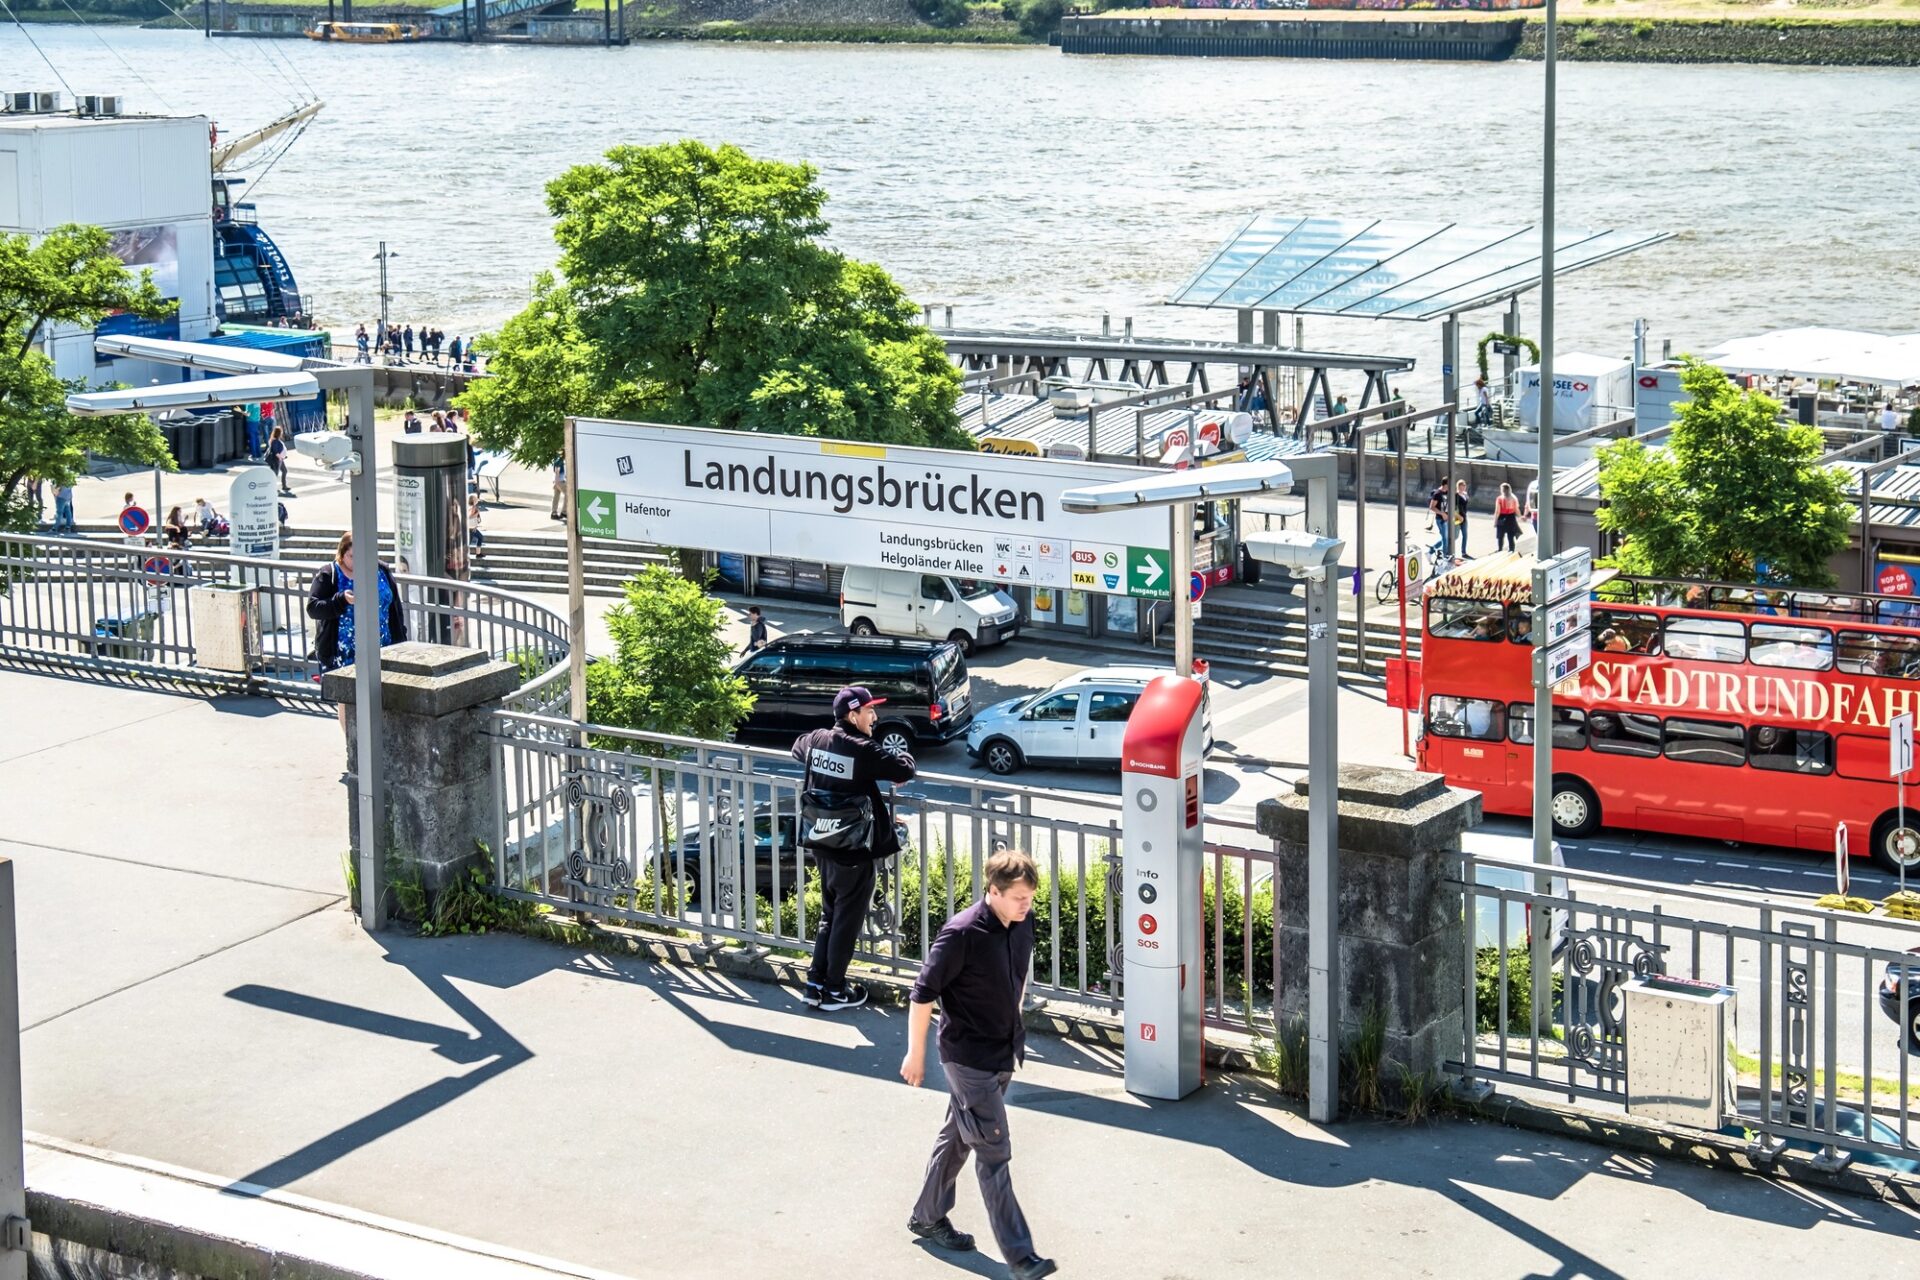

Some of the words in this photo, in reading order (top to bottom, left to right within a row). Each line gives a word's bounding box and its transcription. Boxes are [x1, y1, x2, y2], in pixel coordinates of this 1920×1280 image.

[684, 449, 1045, 522] Landungsbrücken
[625, 502, 671, 517] Hafentor
[581, 525, 605, 535] Ausgang
[880, 531, 984, 553] Landungsbrücken
[996, 543, 1010, 552] WC
[881, 551, 952, 569] Helgoländer
[954, 559, 984, 573] Allee
[1075, 552, 1093, 561] BUS
[1074, 574, 1095, 583] TAXI
[1131, 586, 1158, 596] Ausgang
[1896, 583, 1908, 591] OFF
[1591, 660, 1920, 732] STADTRUNDFAH
[811, 754, 845, 774] didas
[1135, 761, 1166, 770] HOCHBAHN
[815, 818, 842, 831] NIKE
[1136, 869, 1159, 880] Info
[1137, 938, 1159, 950] SOS
